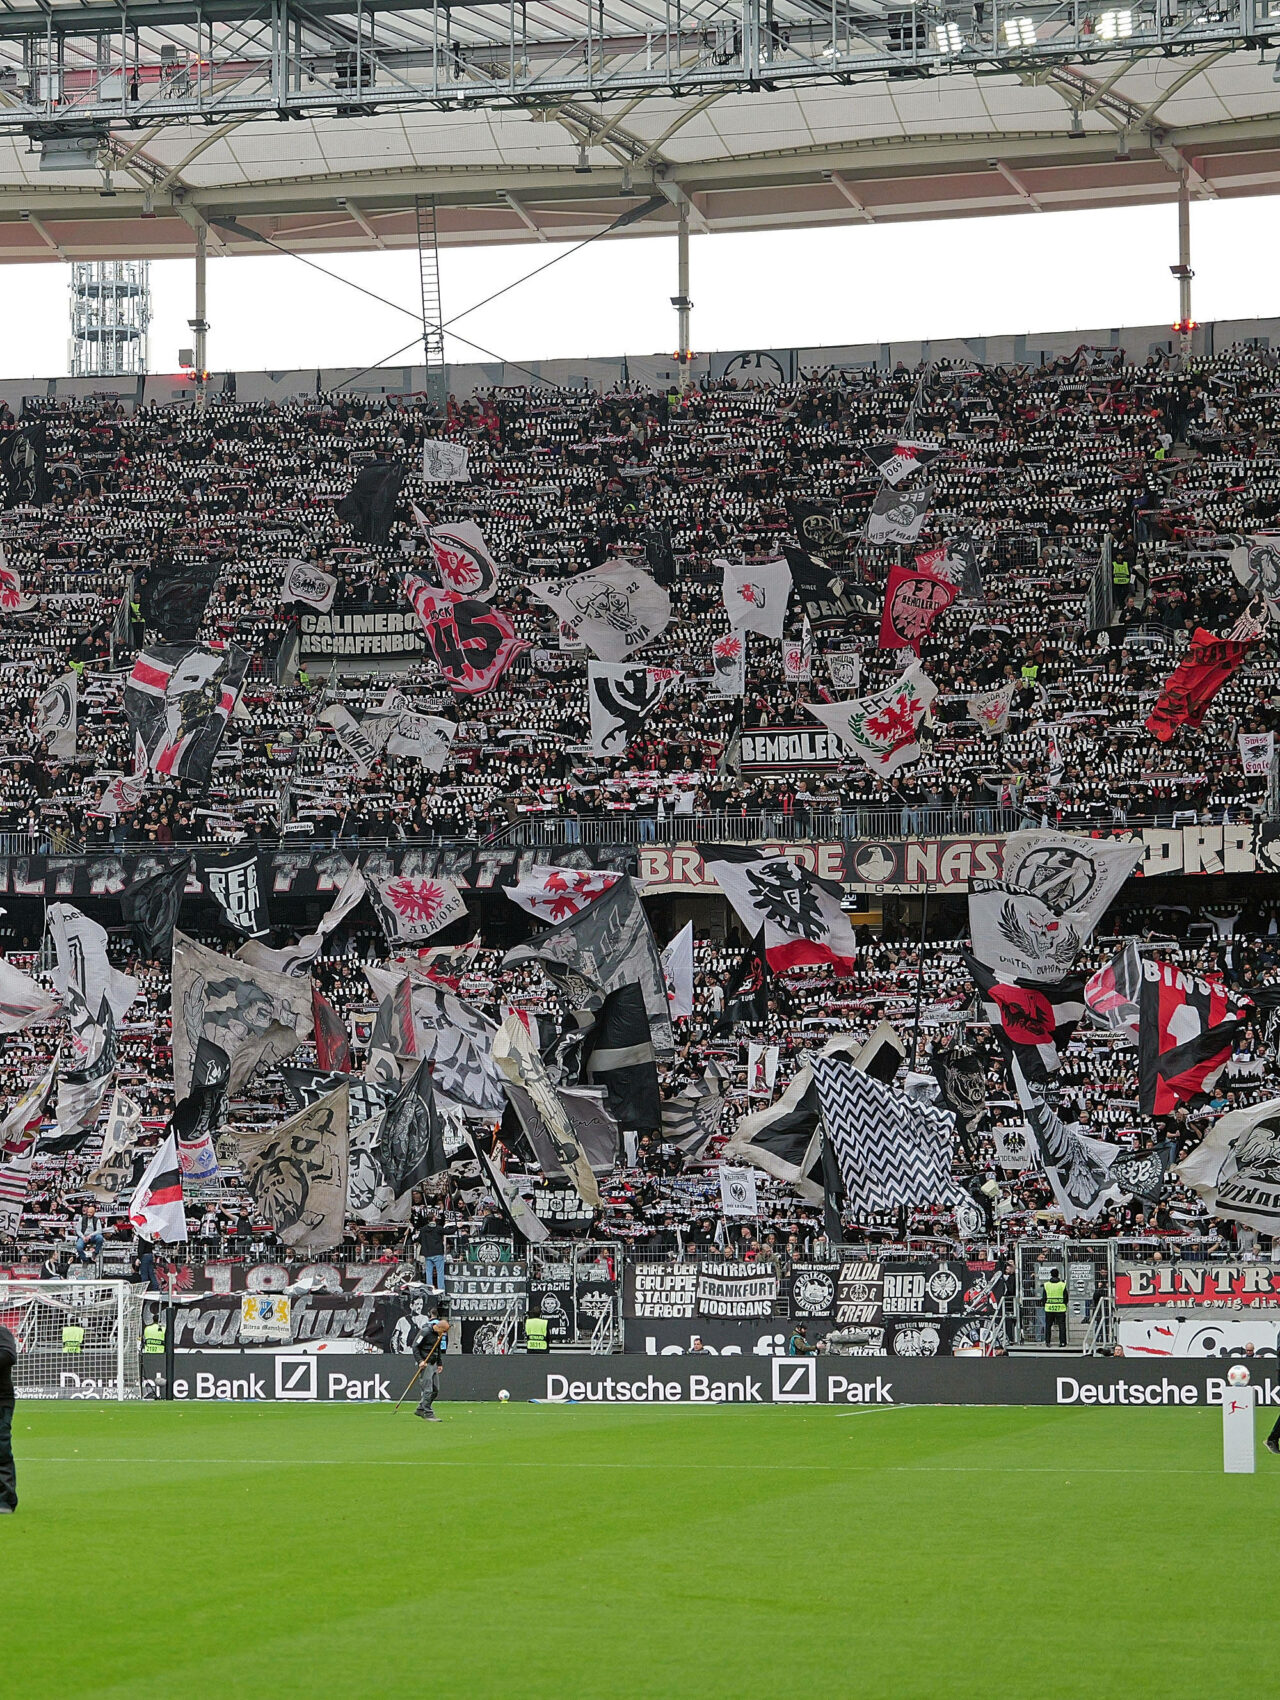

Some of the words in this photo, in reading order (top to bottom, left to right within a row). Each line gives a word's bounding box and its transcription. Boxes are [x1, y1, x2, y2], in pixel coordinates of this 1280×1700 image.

[624, 624, 650, 646] DIVA
[741, 733, 844, 761] BEMBOLER
[905, 841, 1008, 887] NAS
[402, 894, 461, 935] ARRIORS
[448, 1264, 522, 1277] ULTRAS
[635, 1264, 665, 1276] EHRE
[701, 1261, 774, 1277] EINTRACHT
[839, 1263, 879, 1281] FULDA
[453, 1281, 515, 1293] NEVER
[635, 1276, 697, 1290] GRUPPE
[702, 1280, 775, 1298] FRANKFURT
[883, 1275, 925, 1297] RIED
[1128, 1267, 1280, 1296] EINTR
[634, 1291, 696, 1304] STADION
[882, 1298, 925, 1312] GEBIET
[1166, 1297, 1196, 1309] auf
[1204, 1297, 1243, 1311] ewig
[634, 1304, 695, 1318] VERBOT
[699, 1300, 772, 1316] HOOLIGANS
[836, 1305, 878, 1323] CREW
[197, 1372, 266, 1399] Bank
[328, 1373, 392, 1400] Park
[546, 1374, 681, 1401] Deutsche
[689, 1374, 763, 1401] Bank
[828, 1375, 894, 1402] Park
[1056, 1377, 1198, 1405] Deutsche
